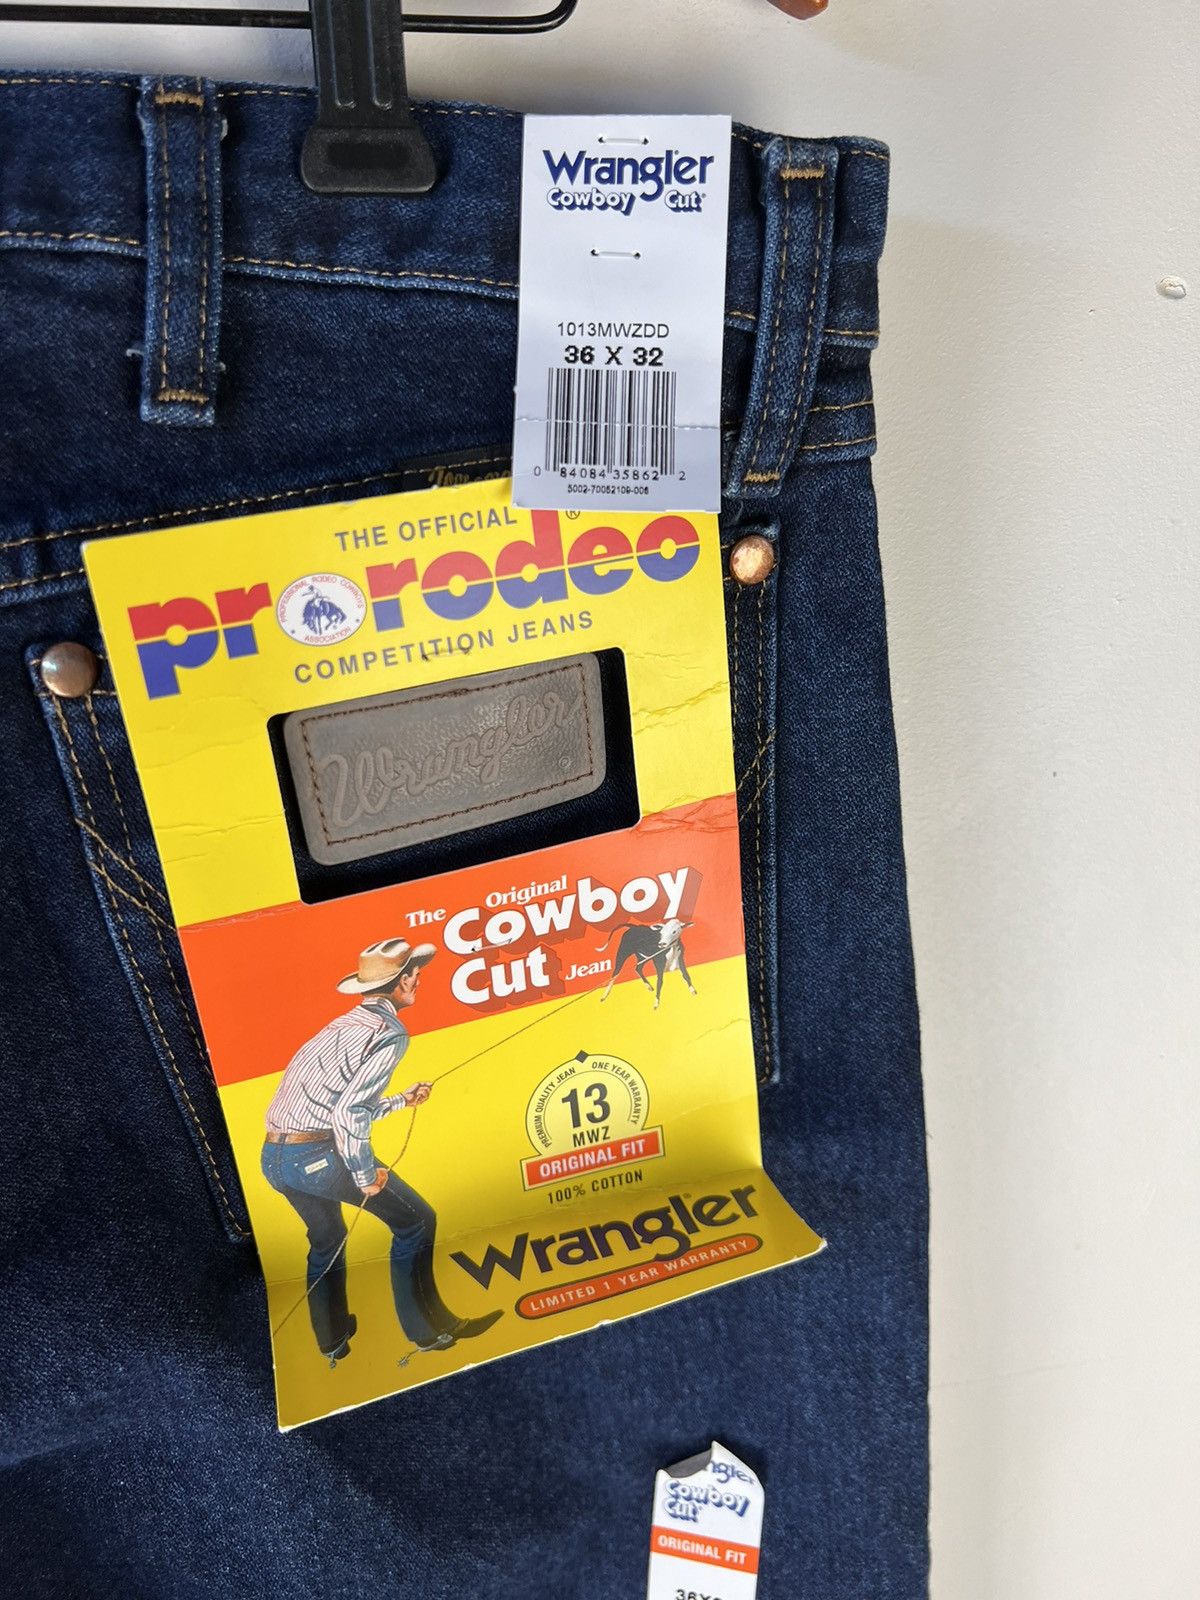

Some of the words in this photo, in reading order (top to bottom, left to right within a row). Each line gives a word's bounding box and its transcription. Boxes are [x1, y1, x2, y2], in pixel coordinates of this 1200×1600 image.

[543, 150, 715, 201] Wrangler
[547, 188, 636, 216] Cowboy
[664, 190, 702, 212] Cut
[557, 322, 670, 338] 1013MWZDD
[564, 345, 596, 365] 36
[605, 346, 624, 365] X
[632, 347, 664, 367] 32
[335, 525, 389, 552] THE
[399, 506, 517, 542] OFFICIAL
[294, 629, 495, 684] COMPETITION
[507, 610, 593, 644] JEANS
[315, 692, 580, 828] Wrangler
[443, 866, 698, 955] Cowboy
[485, 874, 568, 908] Original
[405, 908, 446, 928] The
[451, 946, 556, 1004] Cut
[565, 957, 612, 980] Jean
[535, 1082, 556, 1113] QUALITY
[556, 1067, 576, 1084] JEAN
[561, 1083, 611, 1128] 13
[592, 1061, 609, 1070] ONE
[611, 1064, 631, 1081] YEAR
[628, 1080, 643, 1125] WARRANTY
[572, 1126, 611, 1147] MWZ
[539, 1147, 617, 1178] ORIGINAL
[621, 1139, 646, 1157] FIT
[548, 1184, 586, 1204] 100%
[591, 1169, 643, 1192] COTTON
[449, 1185, 759, 1290] Wrangler
[529, 1285, 596, 1312] LIMITED
[603, 1281, 610, 1291] 1
[618, 1266, 659, 1286] YEAR
[664, 1239, 749, 1273] WARRANTY
[664, 1497, 700, 1522] Cut
[665, 1480, 751, 1517] Cowboy
[657, 1535, 720, 1560] ORIGINAL
[725, 1550, 747, 1565] FIT
